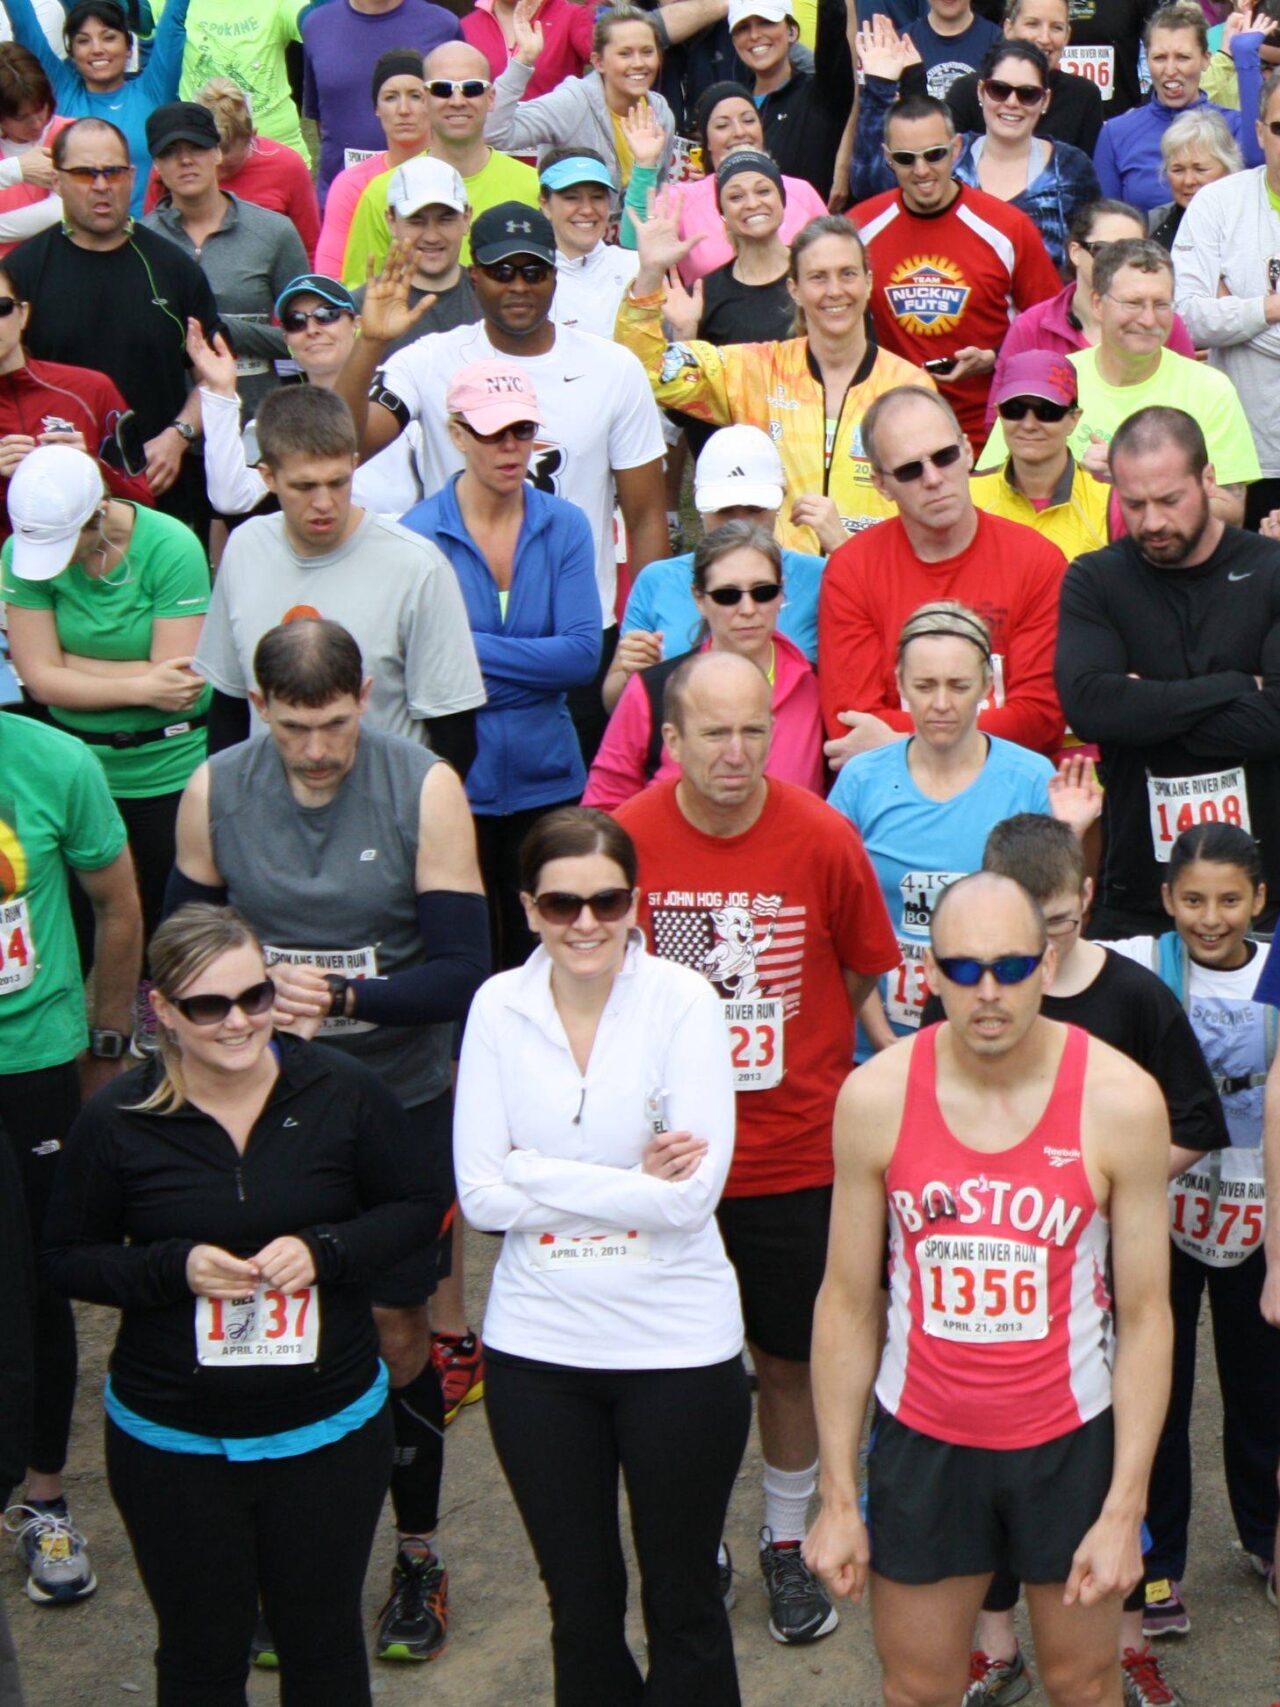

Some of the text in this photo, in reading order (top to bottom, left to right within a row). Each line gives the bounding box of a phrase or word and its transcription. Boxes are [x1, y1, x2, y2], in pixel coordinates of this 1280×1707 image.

[913, 277, 940, 285] TEAM
[893, 288, 960, 302] NUCKIN
[905, 300, 950, 312] FUTS
[486, 376, 523, 394] NYC
[1154, 775, 1239, 798] SPOKANE RIVER RUN
[649, 893, 750, 909] ST JOHN HOG JOG
[0, 926, 28, 968] 4
[271, 951, 367, 969] SPOKANE RIVER RUN
[725, 1002, 776, 1020] RIVER RUN
[729, 1025, 776, 1068] 23
[738, 1073, 762, 1082] 2013
[1044, 1146, 1080, 1159] Reebok
[1220, 1182, 1246, 1199] RIVER
[1248, 1184, 1265, 1200] RUN
[891, 1178, 1082, 1247] BOSTON
[1172, 1193, 1264, 1247] 1375
[550, 1247, 628, 1260] APRIL 21, 2013
[924, 1240, 1037, 1263] SPOKANE RIVER RUN
[930, 1265, 1037, 1317] 1356
[208, 1290, 315, 1341] 137
[943, 1319, 1024, 1333] APRIL 21, 2013
[221, 1345, 302, 1357] APRIL 21, 2013
